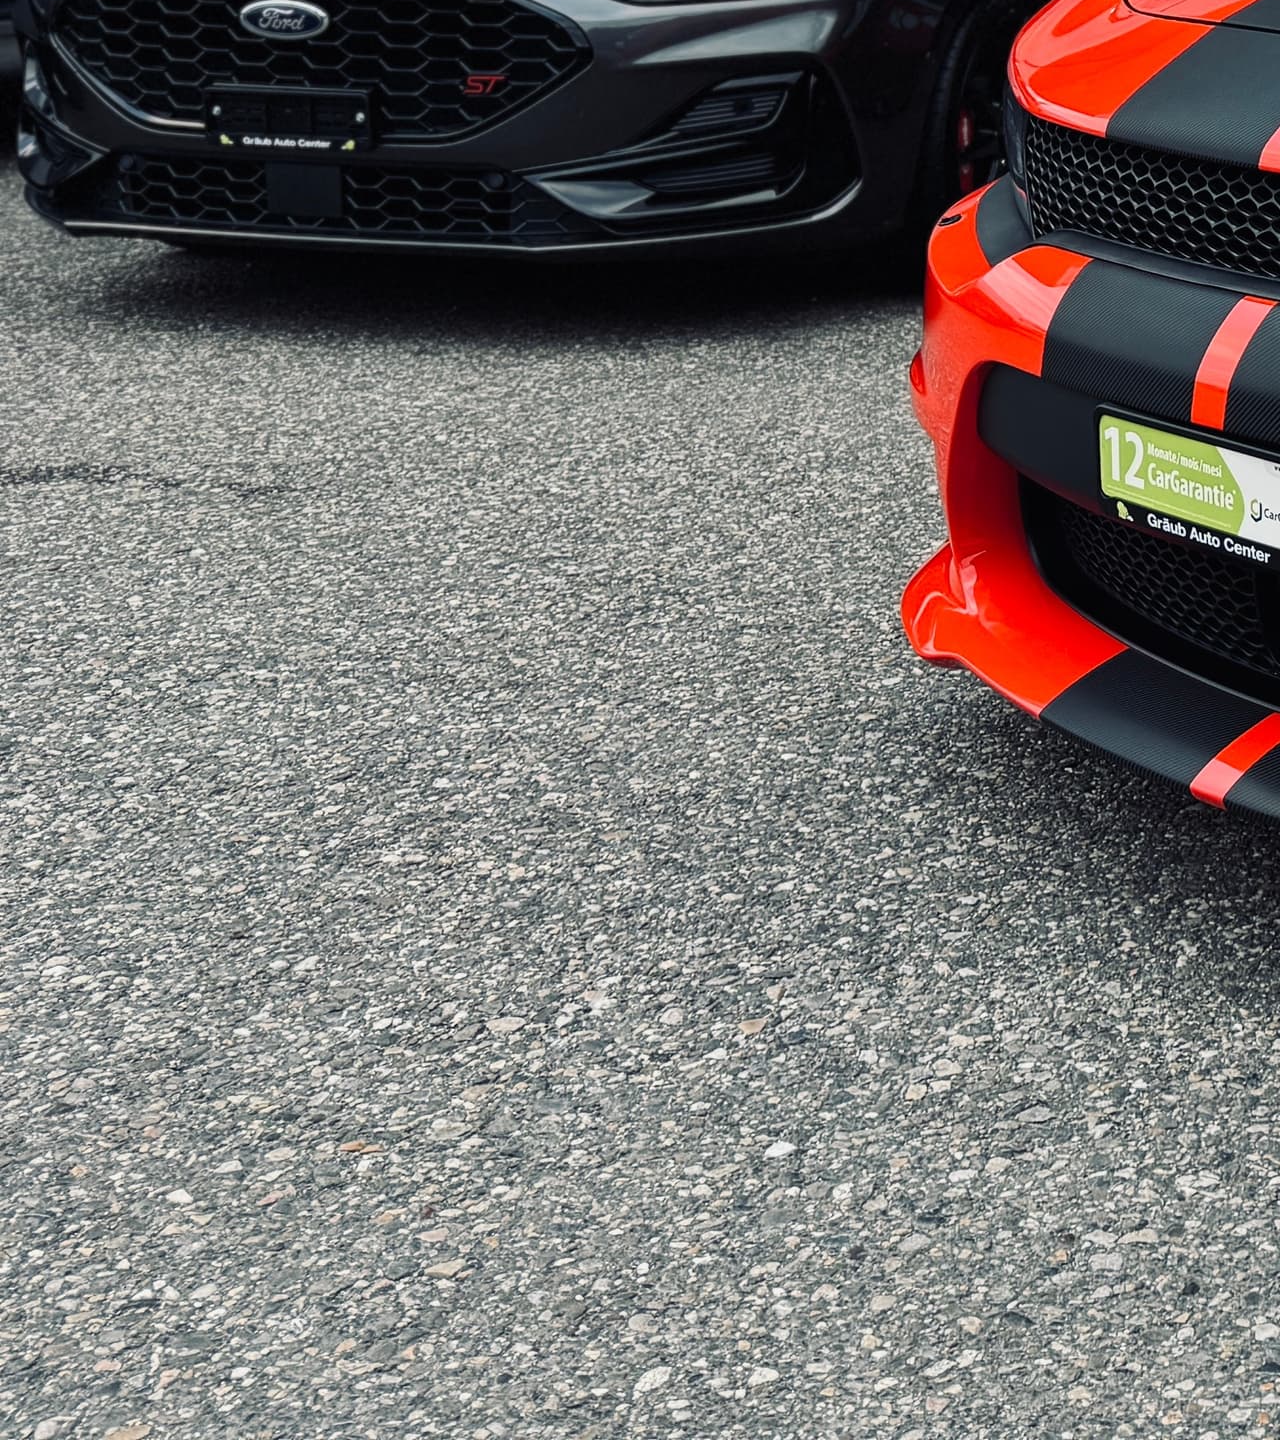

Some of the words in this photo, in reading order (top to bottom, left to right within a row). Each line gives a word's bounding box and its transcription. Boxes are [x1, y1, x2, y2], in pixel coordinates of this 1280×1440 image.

[258, 7, 306, 29] Ford
[463, 75, 507, 94] ST
[274, 138, 296, 147] Auto
[1104, 427, 1145, 490] 12
[1146, 513, 1187, 537] Gräub
[1189, 527, 1221, 548] Auto
[1223, 537, 1271, 564] Center
